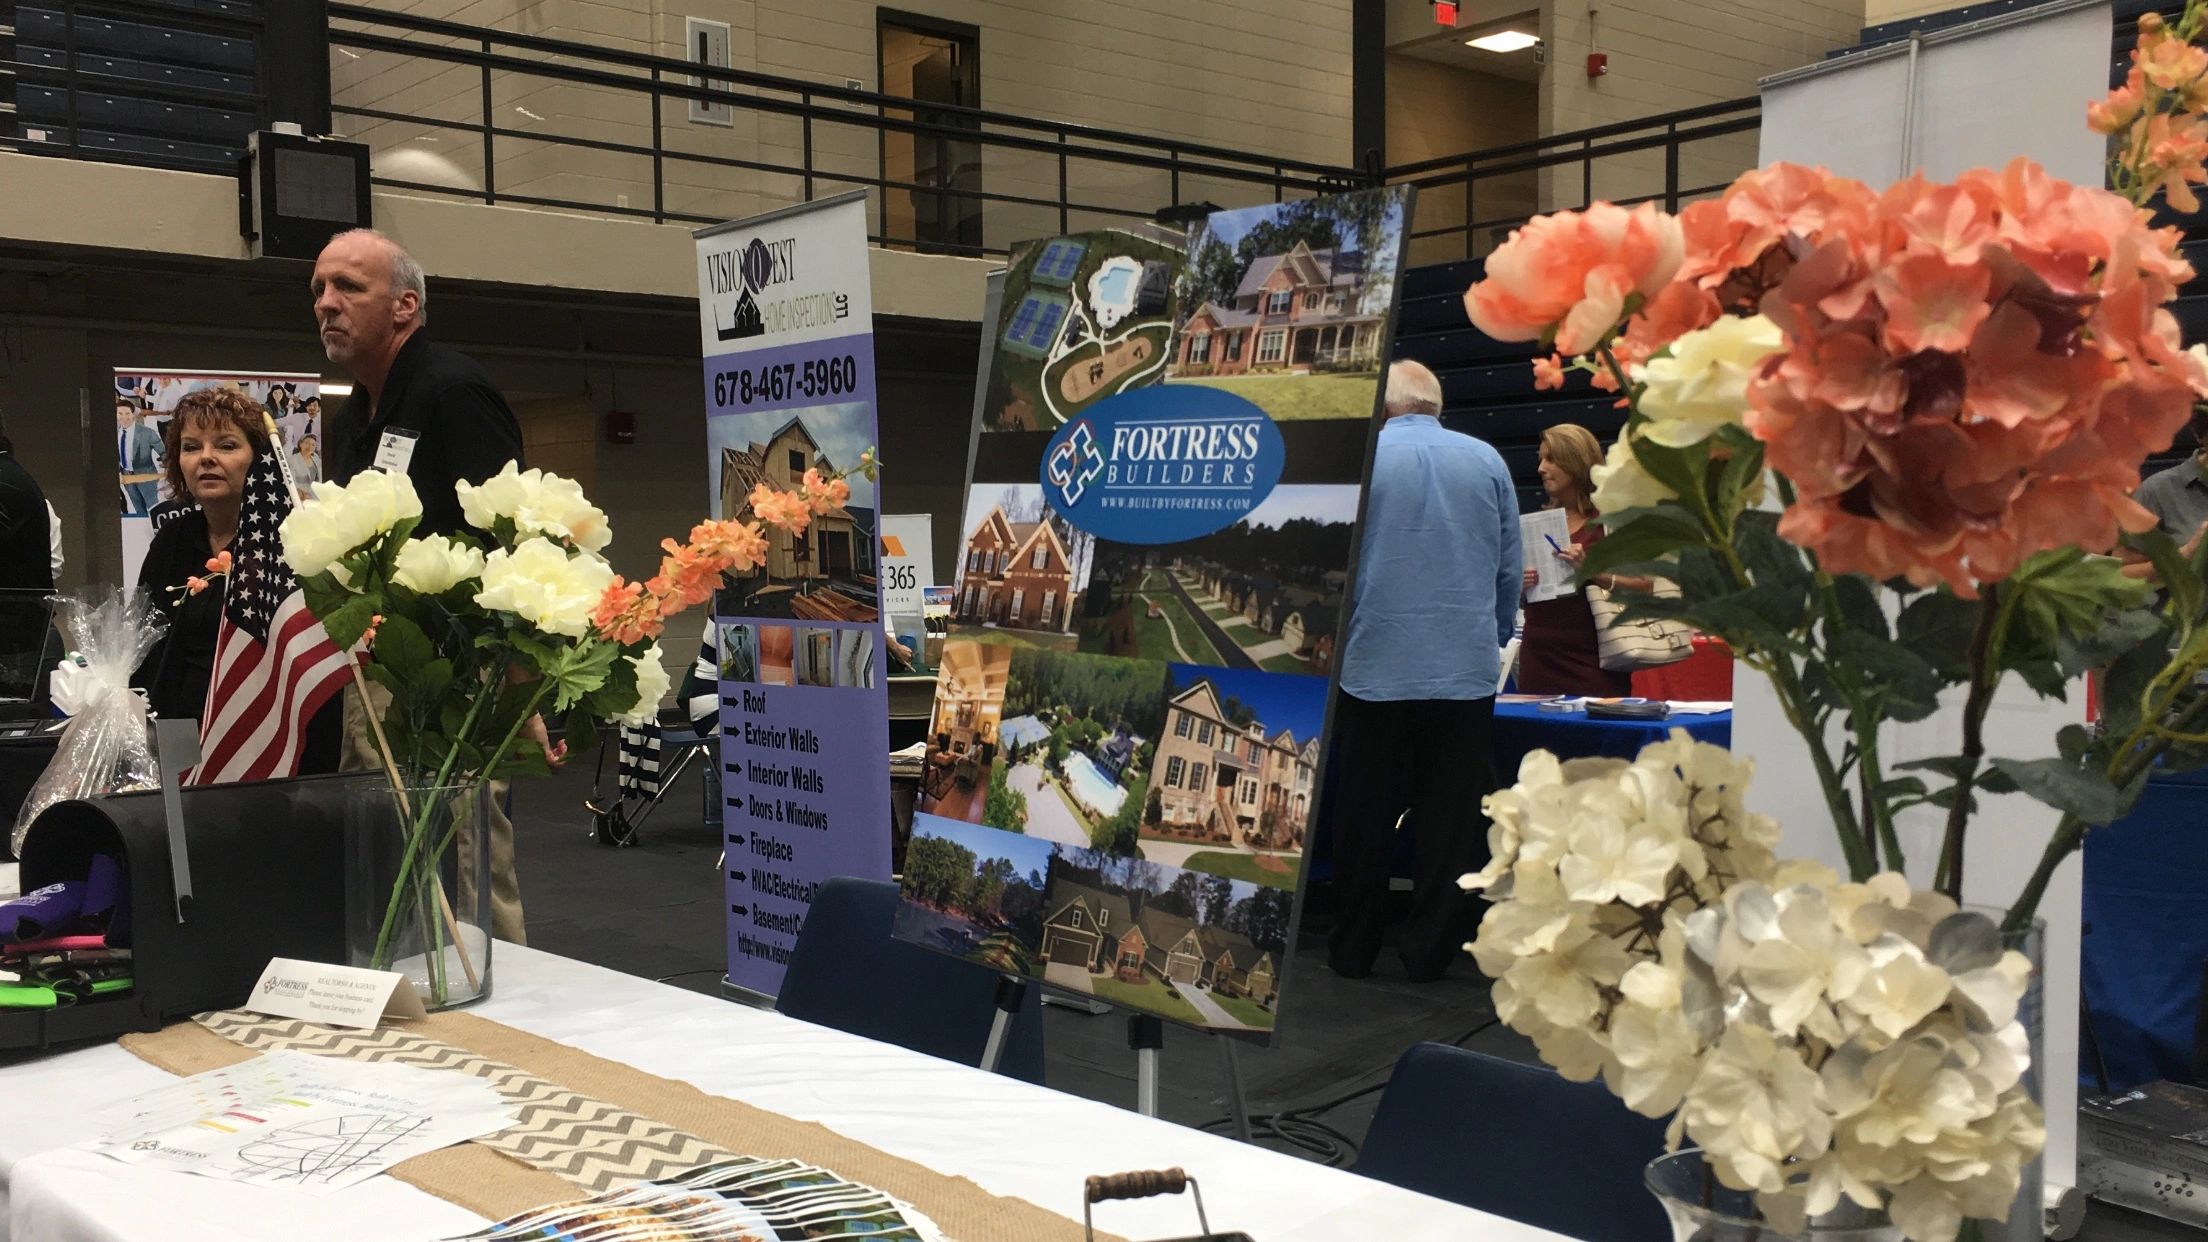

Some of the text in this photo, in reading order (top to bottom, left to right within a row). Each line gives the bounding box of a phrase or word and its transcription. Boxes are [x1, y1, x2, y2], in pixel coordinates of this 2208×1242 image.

[764, 291, 848, 334] HOME INSPECTIONS LLC
[714, 355, 857, 407] 678-467-5960
[1109, 423, 1261, 462] FORTRESS
[1107, 463, 1256, 485] BUILDERS
[1101, 496, 1251, 511] WWW.BUILTBYFORTRESS.COM
[888, 565, 916, 590] 365
[743, 689, 766, 714] Roof
[744, 722, 819, 754] Exterior Walls
[748, 760, 824, 794] Interior Walls
[749, 794, 828, 831] Doors & Windows
[750, 831, 793, 863] Fireplace
[276, 978, 309, 991] FORTRESS
